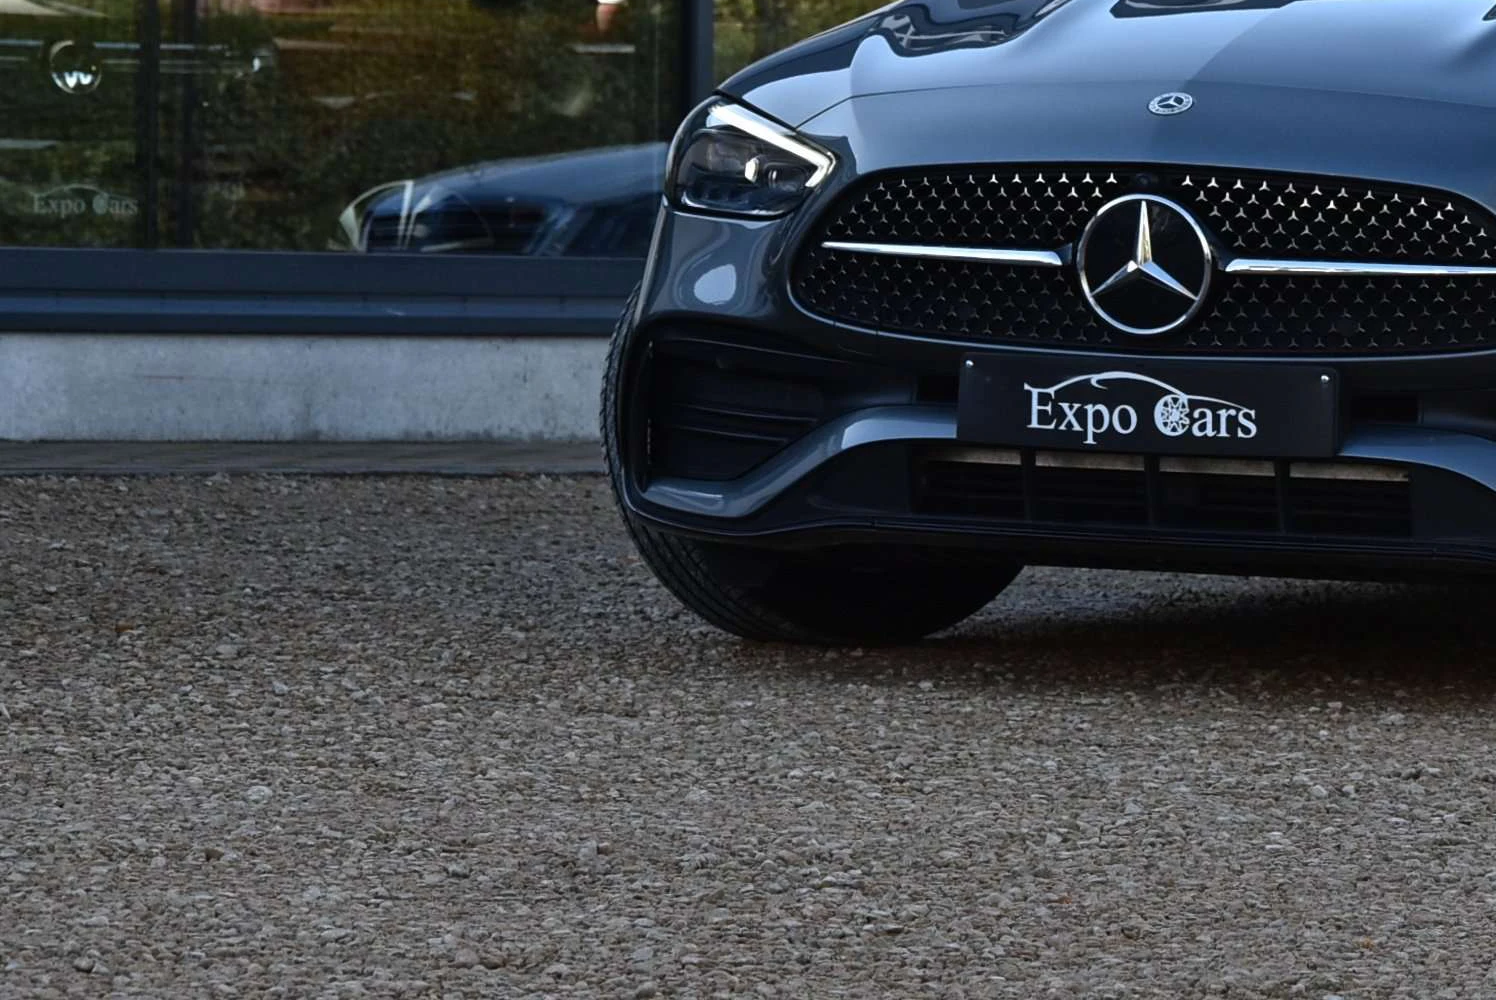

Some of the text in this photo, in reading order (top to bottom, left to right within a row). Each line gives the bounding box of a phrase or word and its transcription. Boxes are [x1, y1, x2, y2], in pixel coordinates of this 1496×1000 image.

[32, 192, 139, 218] Expo Cars
[1024, 385, 1258, 445] Expo Cars
